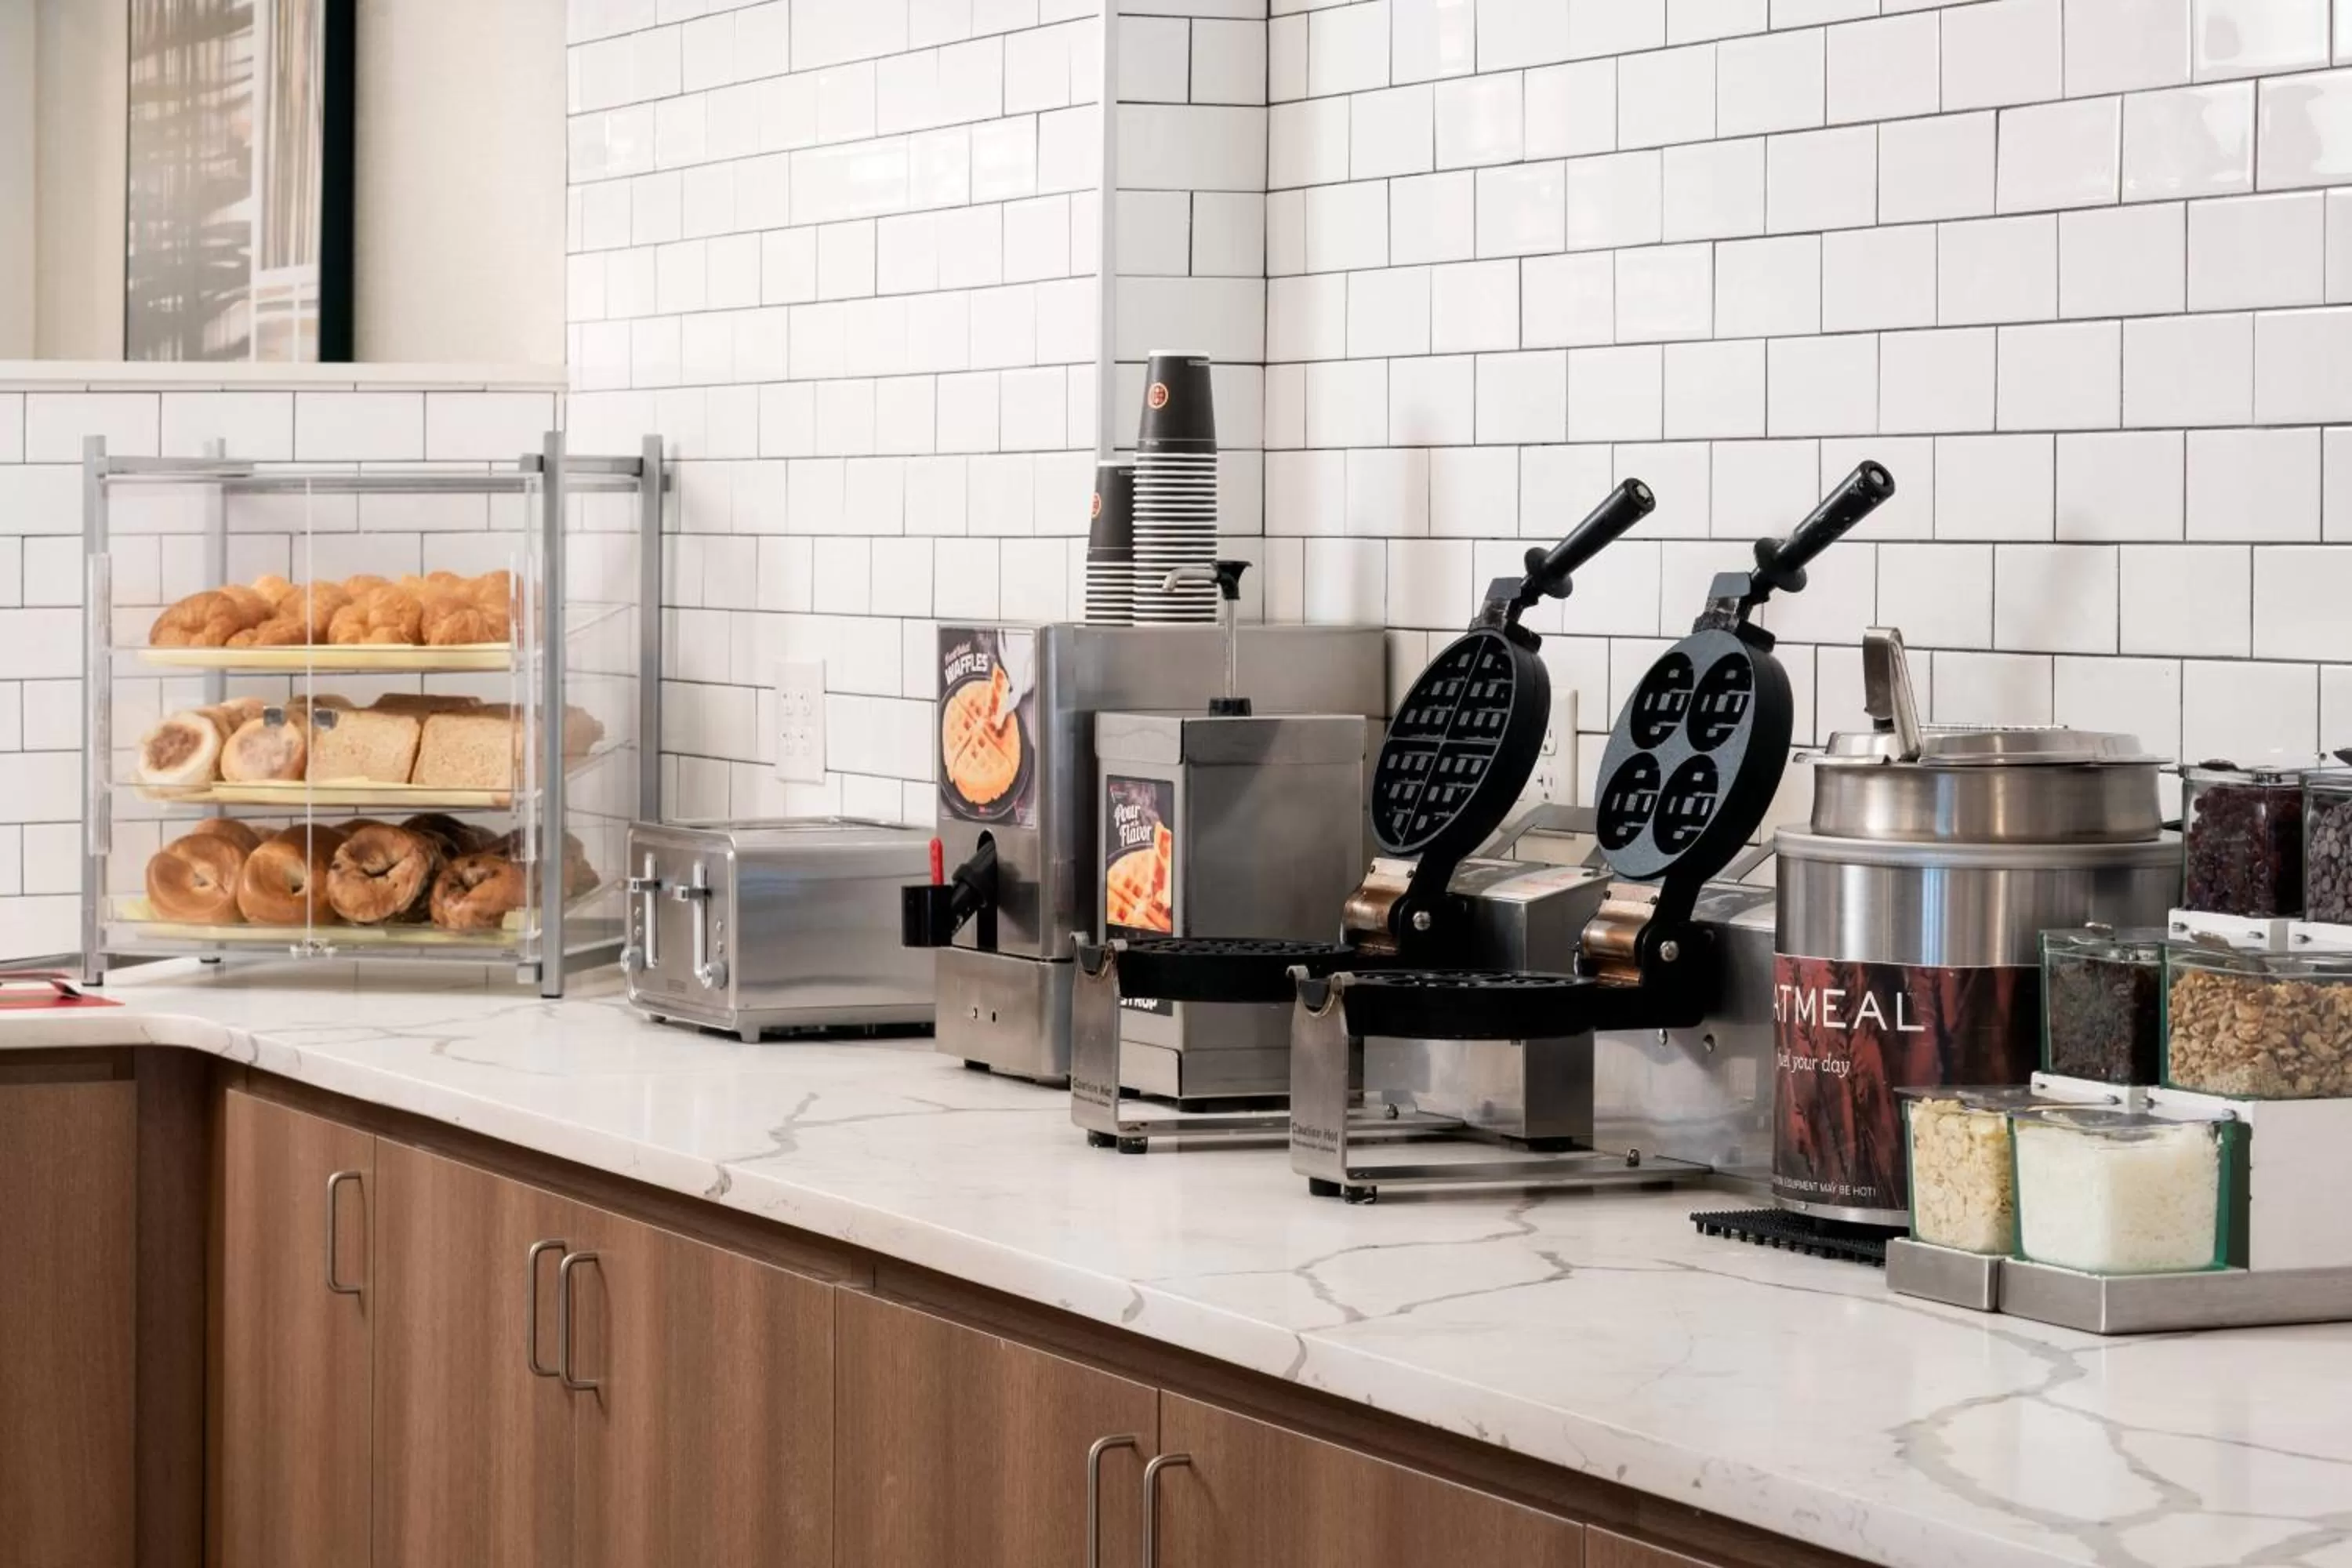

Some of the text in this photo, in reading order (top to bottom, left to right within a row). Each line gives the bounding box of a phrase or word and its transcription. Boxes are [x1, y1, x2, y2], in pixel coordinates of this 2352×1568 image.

[945, 652, 989, 685] WAFFLES
[1114, 804, 1141, 828] Pour
[1119, 824, 1152, 847] Flavor
[1773, 983, 1926, 1032] ATMEAL
[1791, 1056, 1819, 1073] your
[1821, 1051, 1850, 1078] day
[1820, 1181, 1838, 1194] MAY
[1838, 1184, 1852, 1196] BE
